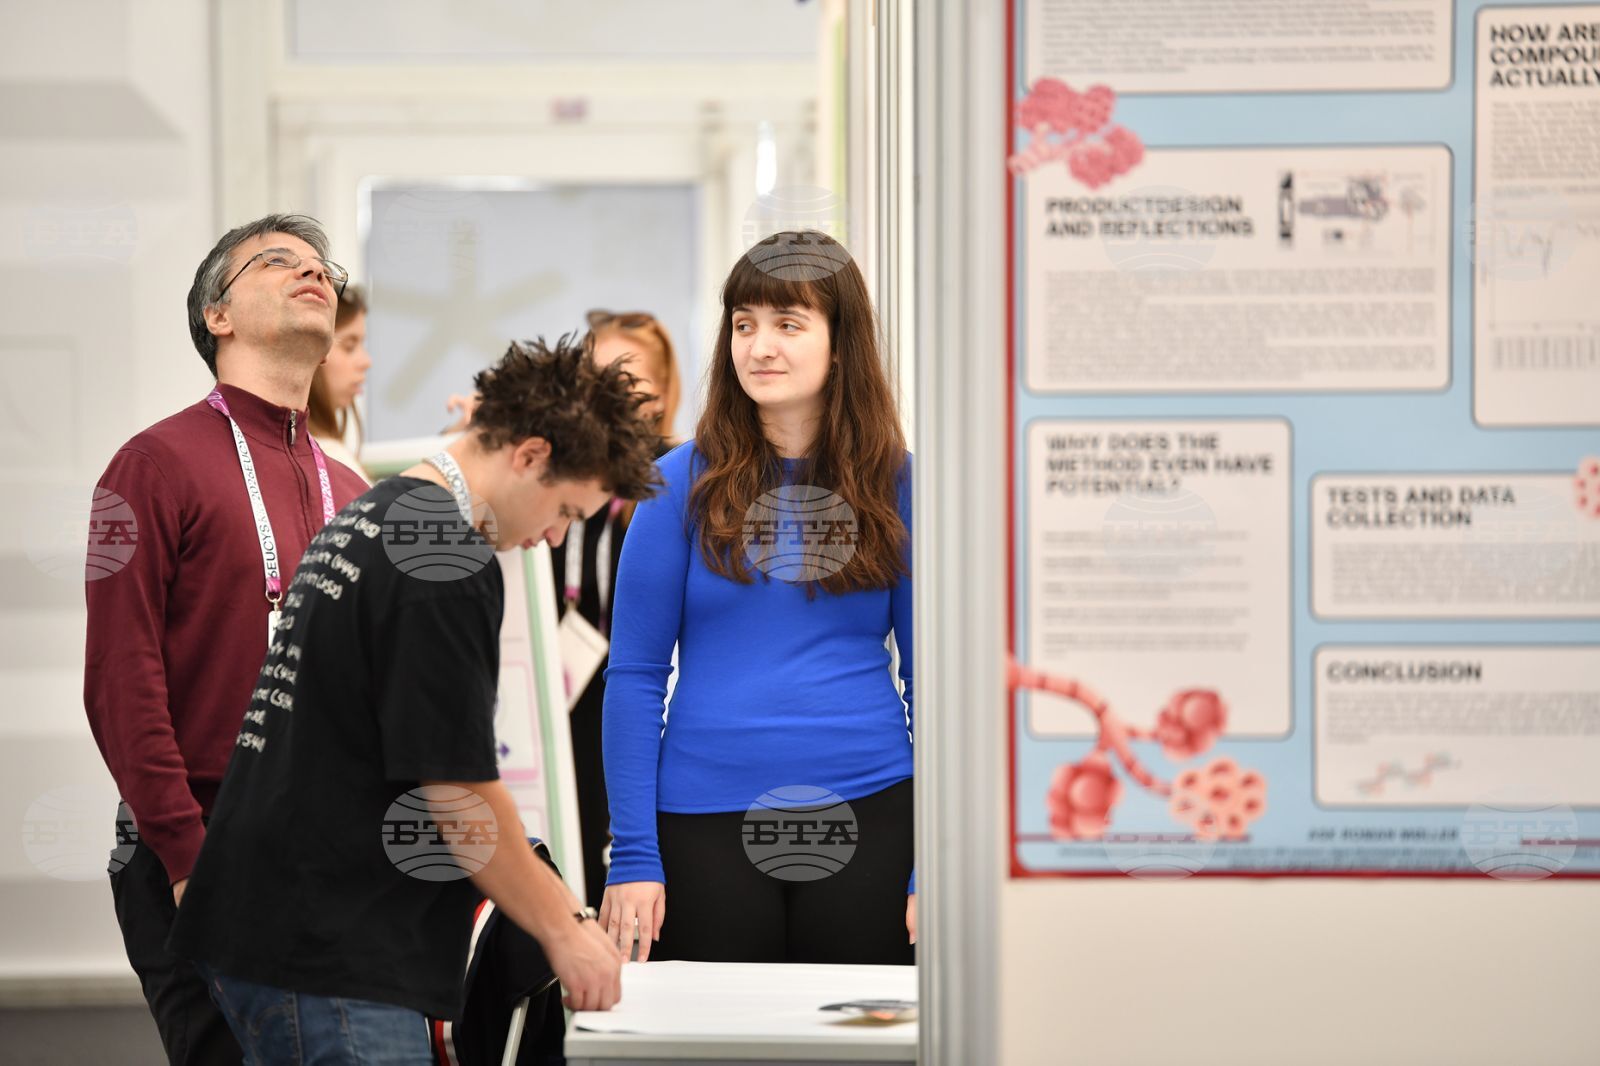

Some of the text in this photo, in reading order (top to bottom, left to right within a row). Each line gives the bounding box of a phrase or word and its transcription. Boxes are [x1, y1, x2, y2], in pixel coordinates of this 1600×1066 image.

[1490, 23, 1550, 42] HOW
[1490, 46, 1600, 65] COMPOU
[1046, 220, 1093, 238] AND
[1100, 218, 1253, 237] REFLECTIONS
[1046, 431, 1218, 450] WHY DOES THE
[1046, 454, 1273, 473] METHOD EVEN HAVE
[1328, 486, 1516, 503] TESTS AND DATA
[1327, 508, 1473, 527] COLLECTION
[1327, 661, 1482, 683] CONCLUSION
